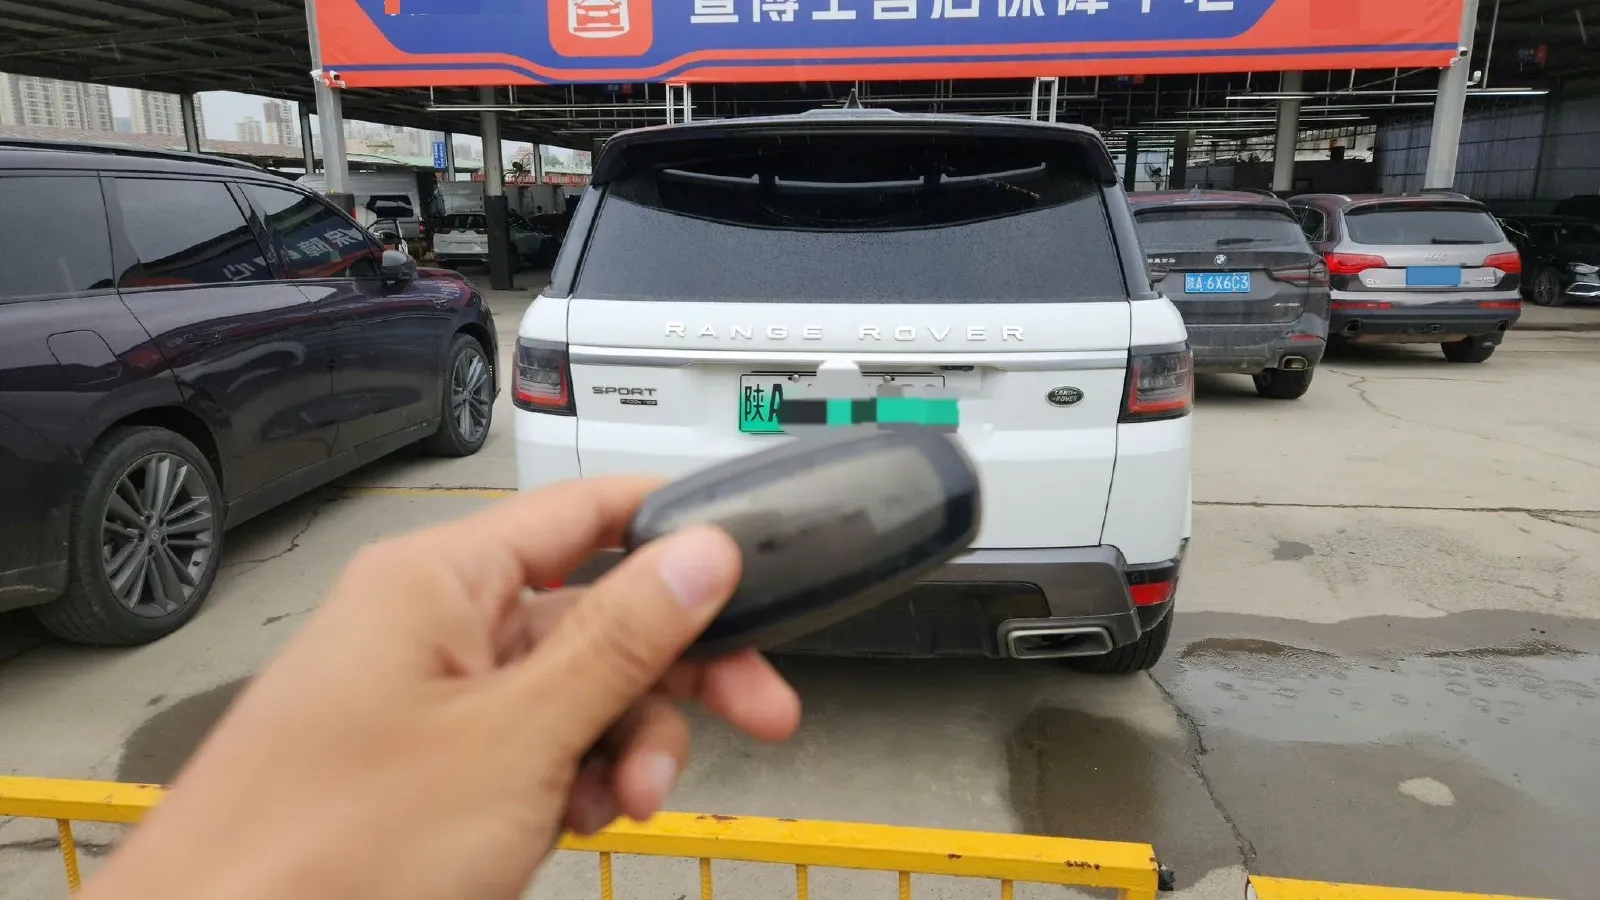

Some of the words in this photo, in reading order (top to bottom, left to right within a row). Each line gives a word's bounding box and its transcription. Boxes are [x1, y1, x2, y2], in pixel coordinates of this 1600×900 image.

[664, 321, 823, 341] RANGE
[858, 324, 1025, 342] ROVER
[592, 386, 657, 396] SPORT
